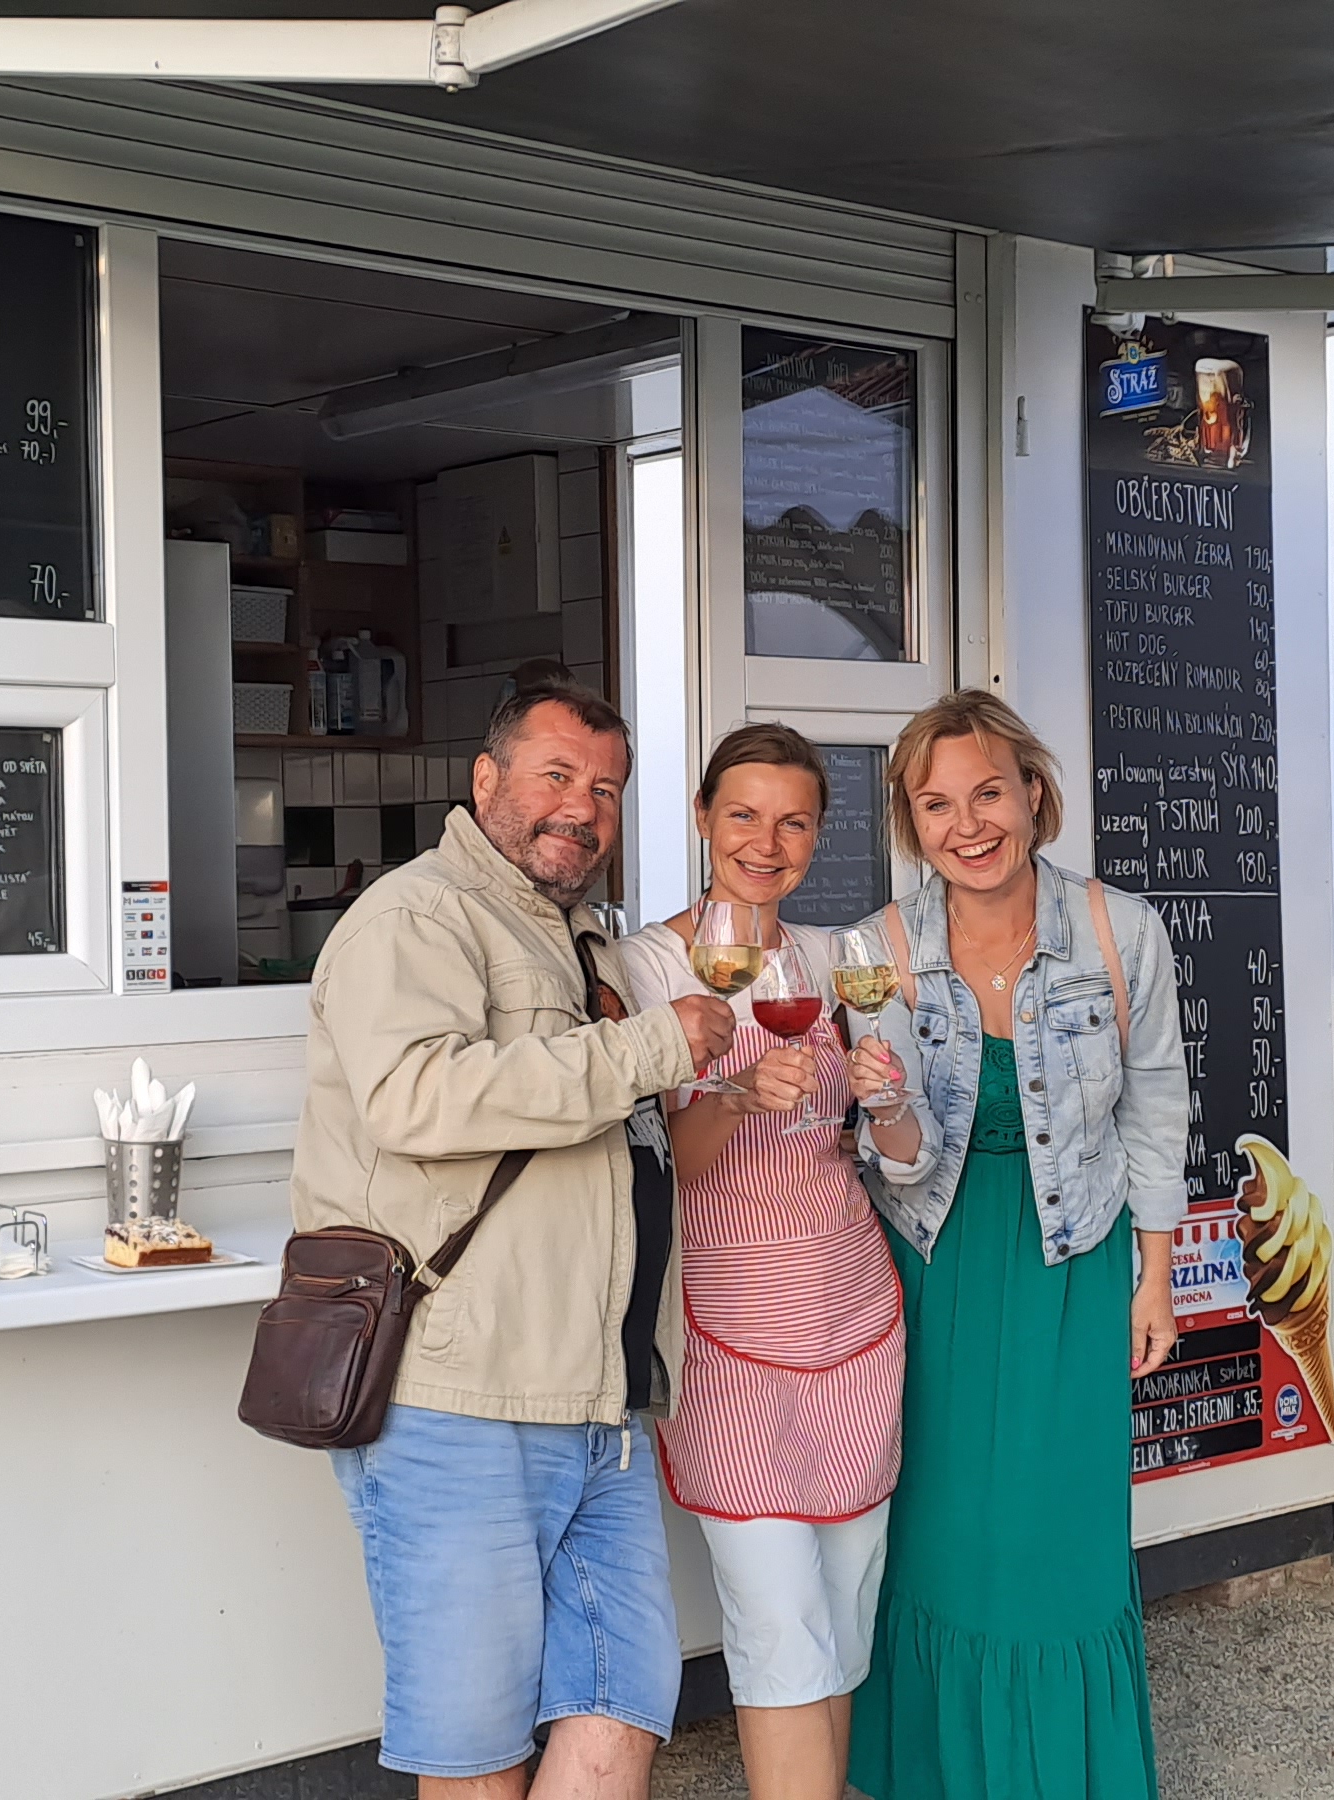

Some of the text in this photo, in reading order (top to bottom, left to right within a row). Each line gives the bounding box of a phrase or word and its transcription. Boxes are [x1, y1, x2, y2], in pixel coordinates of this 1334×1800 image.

[1107, 364, 1160, 405] STRÁŽ
[1116, 475, 1240, 532] OBČERSTVENÍ
[1105, 531, 1190, 565] MARINOVANÁ
[1106, 564, 1157, 591] SELSKÝ
[1163, 572, 1213, 600] BURGER
[1105, 600, 1138, 624] TOFU
[1145, 602, 1196, 626] BURGER
[1106, 630, 1130, 652] HOT
[1138, 633, 1167, 656] DOG
[1107, 651, 1179, 687] ROZPEČENÝ
[1186, 661, 1243, 693] ROMADUR
[1109, 704, 1162, 735] PSTRUH
[1167, 710, 1183, 735] NA
[1185, 702, 1244, 739] BYLINKÁCH
[2, 759, 17, 773] OD
[20, 757, 47, 774] SVĚTA
[1169, 756, 1217, 799] čerstvý
[1221, 743, 1252, 790] SÝR
[1101, 802, 1148, 848] uzený
[1103, 853, 1150, 889] uzený
[1156, 847, 1210, 880] AMUR
[1170, 1260, 1239, 1289] RZLINA
[1173, 1289, 1212, 1306] OPOČNA
[1220, 1356, 1256, 1383] sorbet
[1132, 1407, 1153, 1437] INI
[1132, 1439, 1164, 1472] ELKÁ
